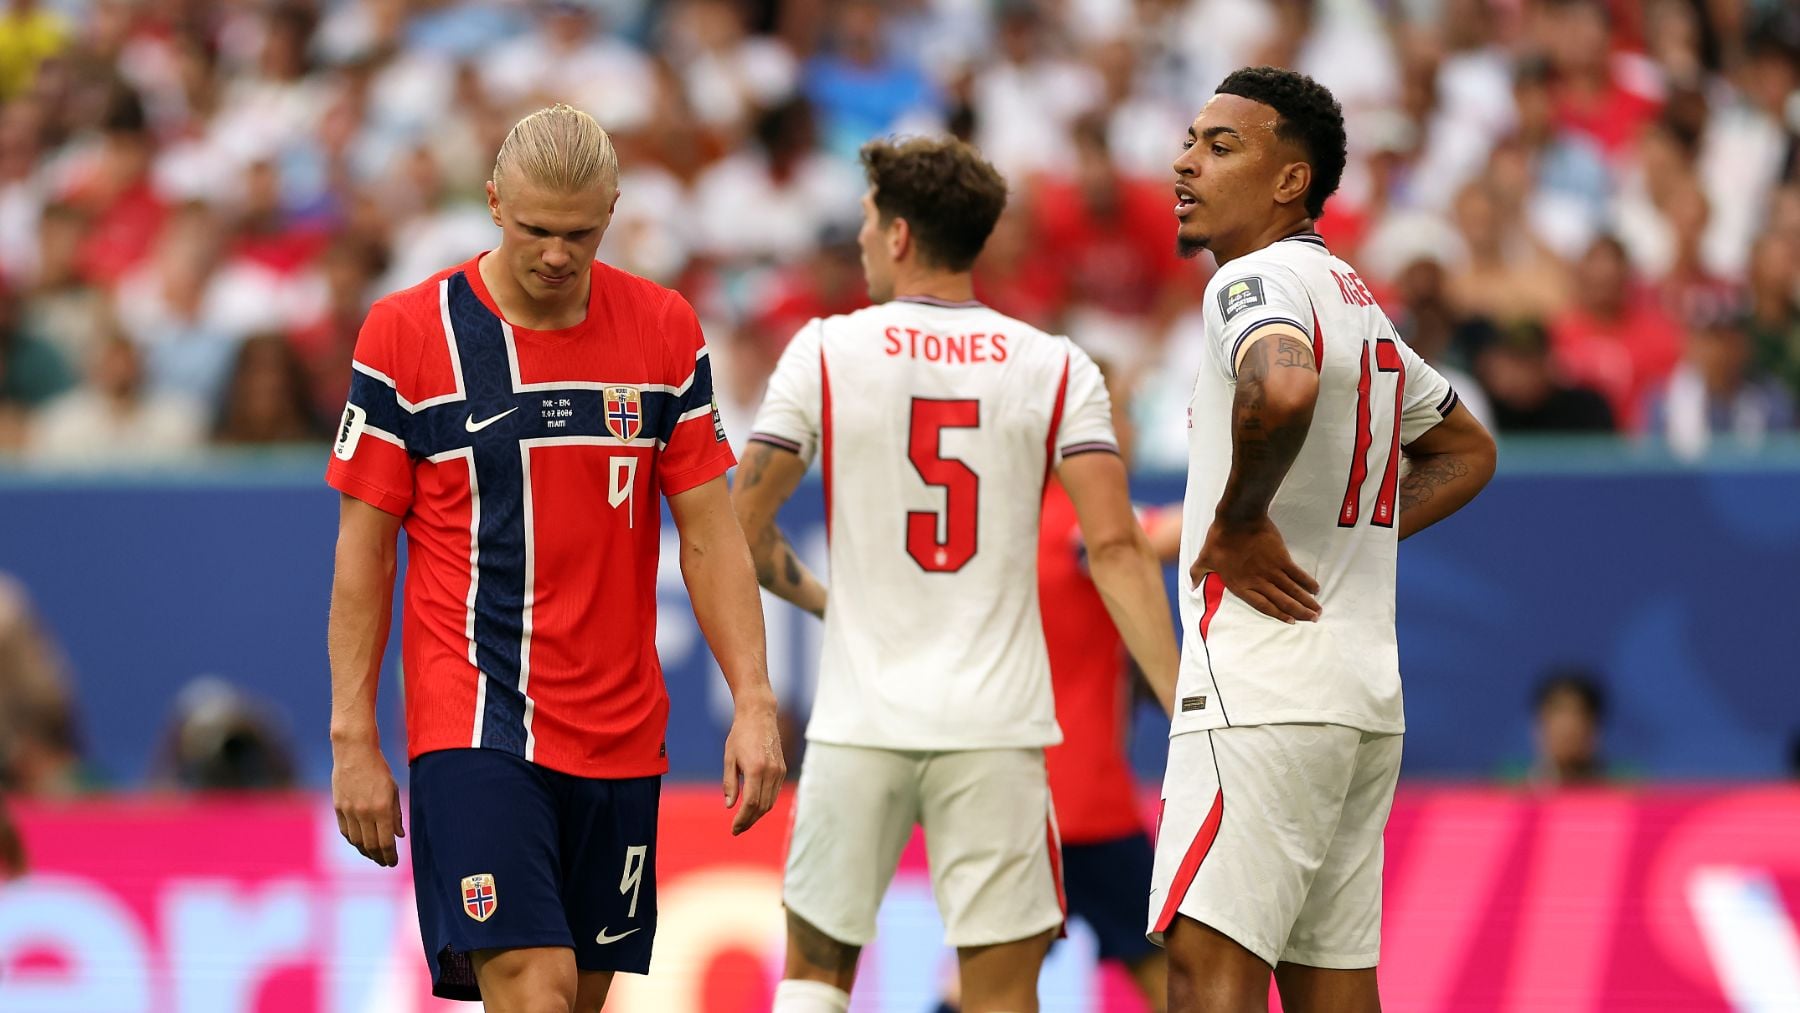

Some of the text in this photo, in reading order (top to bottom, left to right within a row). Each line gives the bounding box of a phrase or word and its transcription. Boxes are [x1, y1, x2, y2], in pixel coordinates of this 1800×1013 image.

[884, 326, 1008, 364] STONES
[1336, 337, 1406, 529] 17
[608, 455, 639, 529] 9
[906, 396, 980, 573] 5
[619, 844, 647, 918] 9
